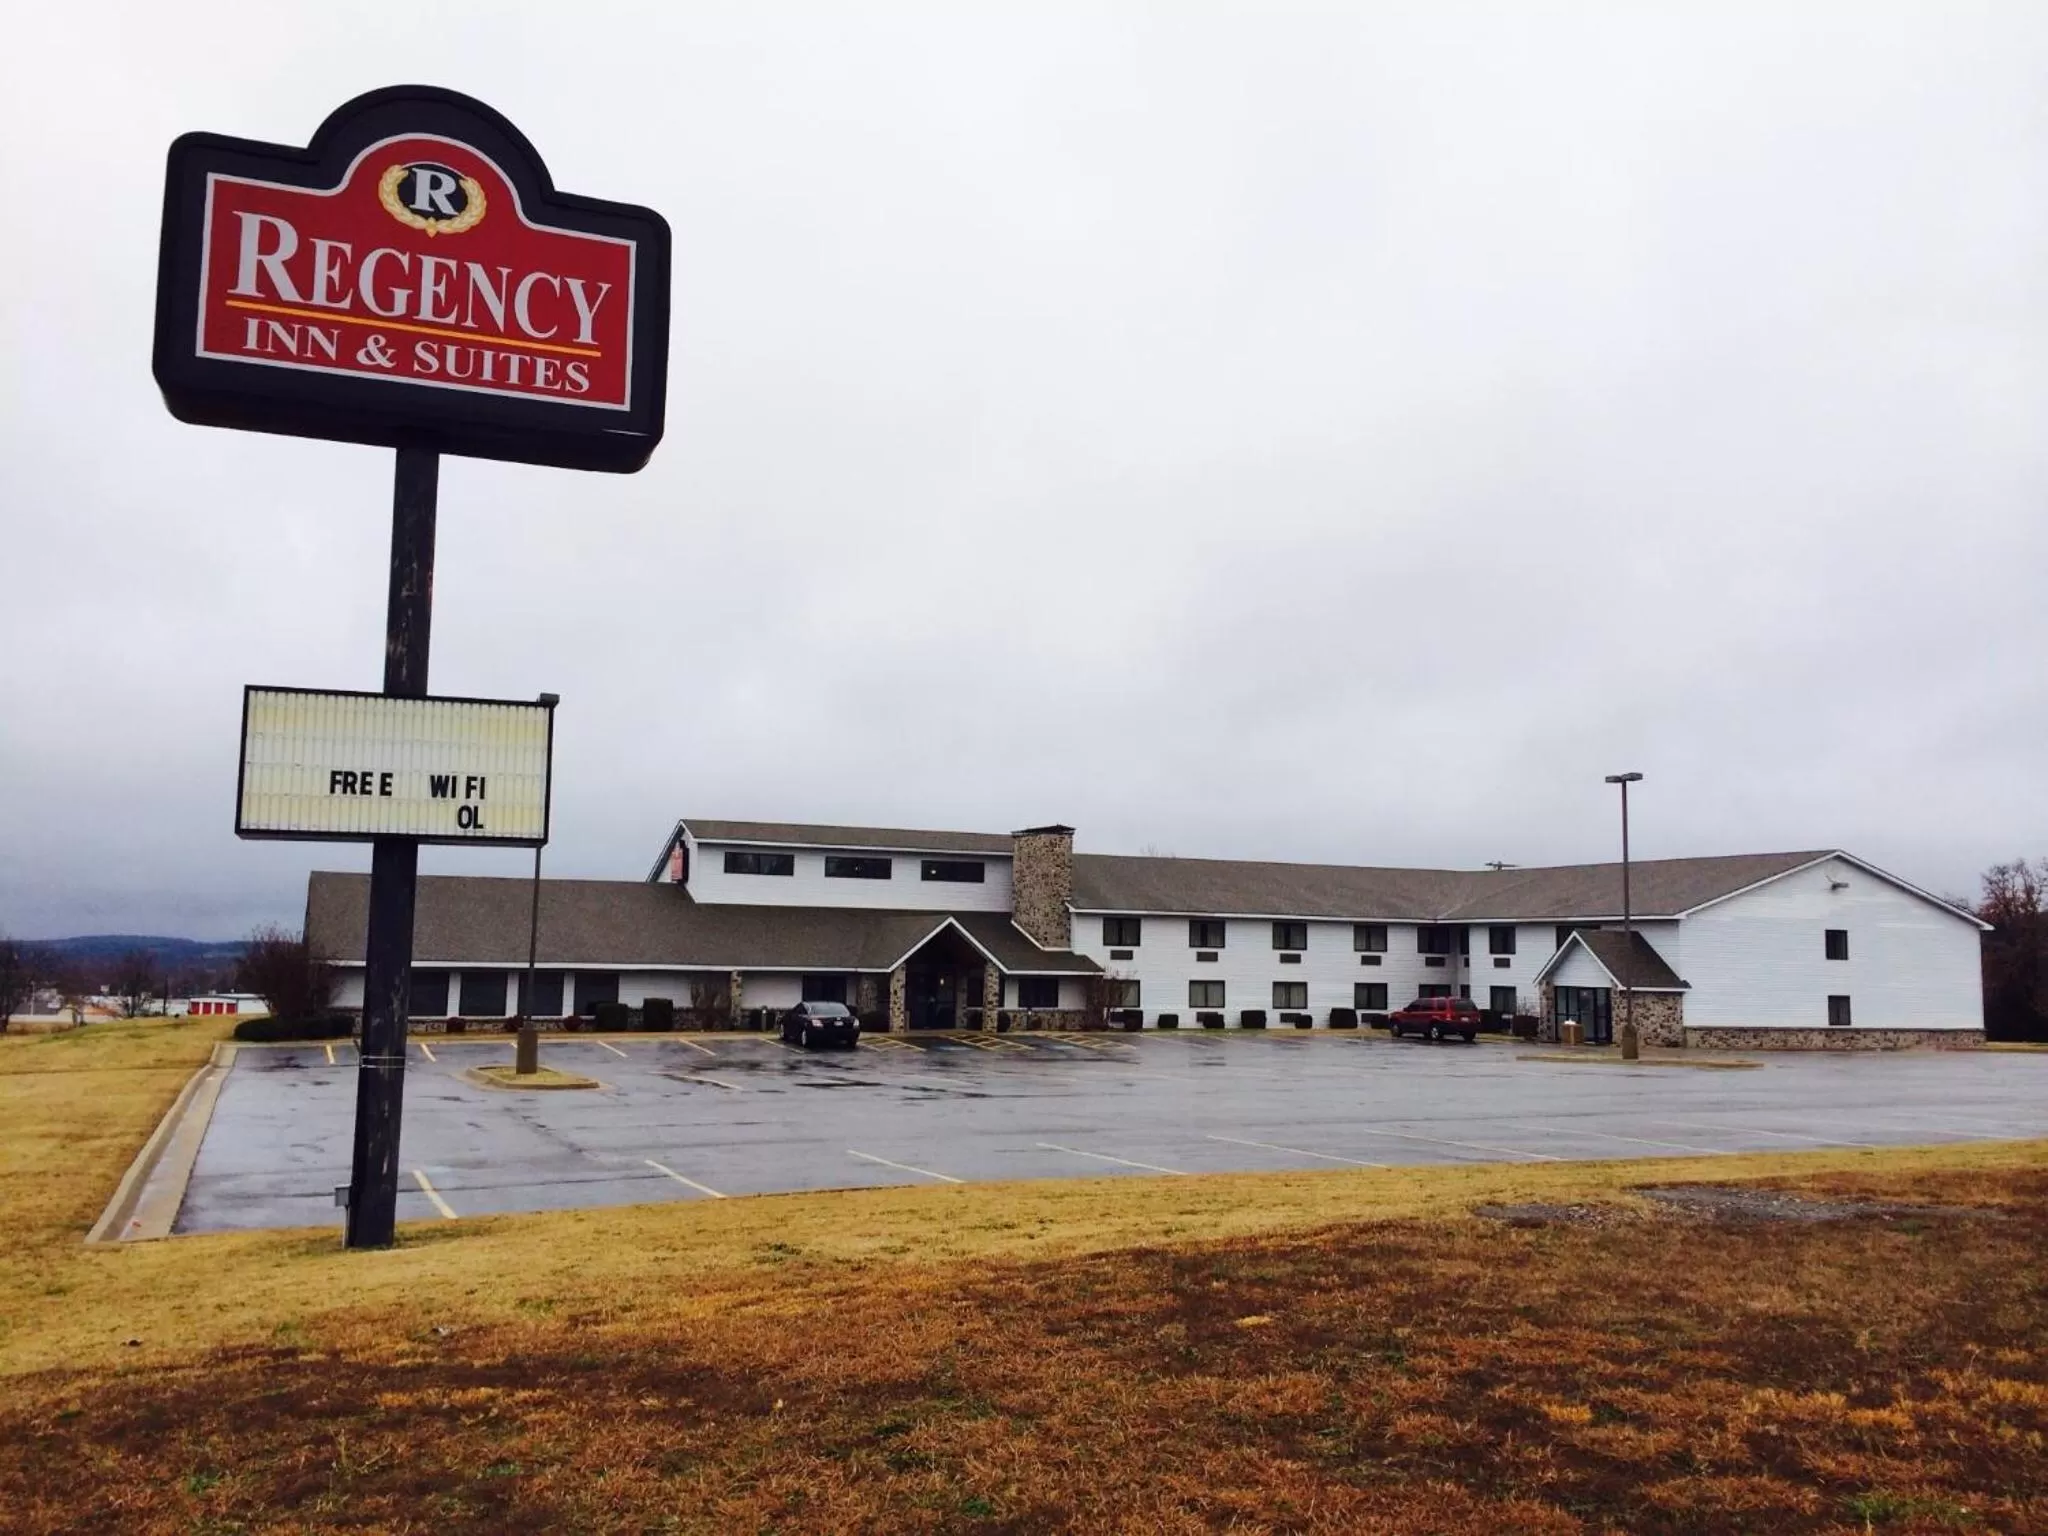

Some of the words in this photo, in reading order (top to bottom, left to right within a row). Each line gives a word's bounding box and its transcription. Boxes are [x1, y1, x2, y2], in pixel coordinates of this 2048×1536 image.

[409, 167, 460, 216] R
[227, 210, 613, 345] REGENCY
[242, 317, 339, 360] INN
[356, 334, 396, 368] &
[413, 341, 590, 393] SUITES
[329, 770, 393, 797] FREE
[456, 804, 485, 830] OL
